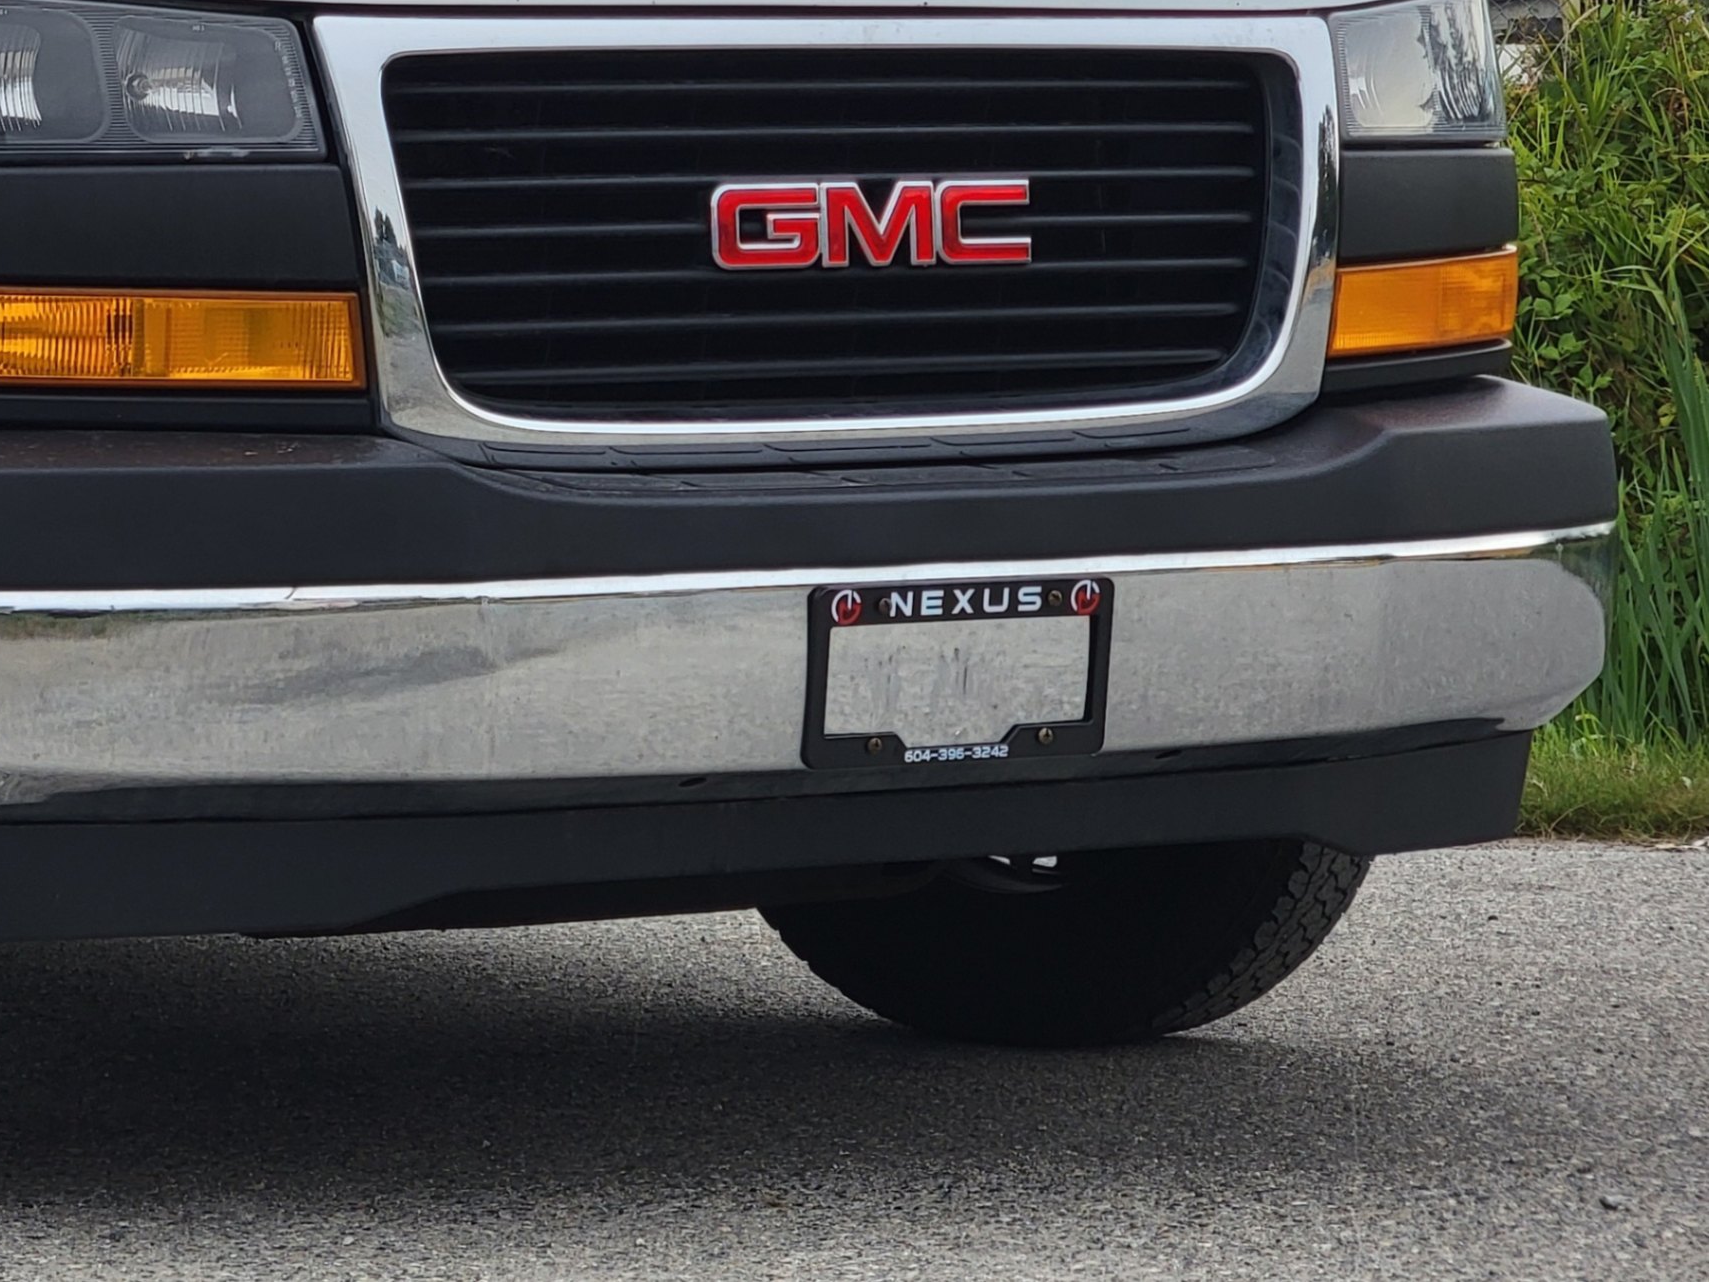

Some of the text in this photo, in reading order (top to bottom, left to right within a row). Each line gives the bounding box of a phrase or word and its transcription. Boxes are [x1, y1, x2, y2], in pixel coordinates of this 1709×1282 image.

[711, 179, 1032, 270] GMC
[890, 586, 1042, 617] NEXUS
[904, 745, 1009, 763] 604-396-3242
